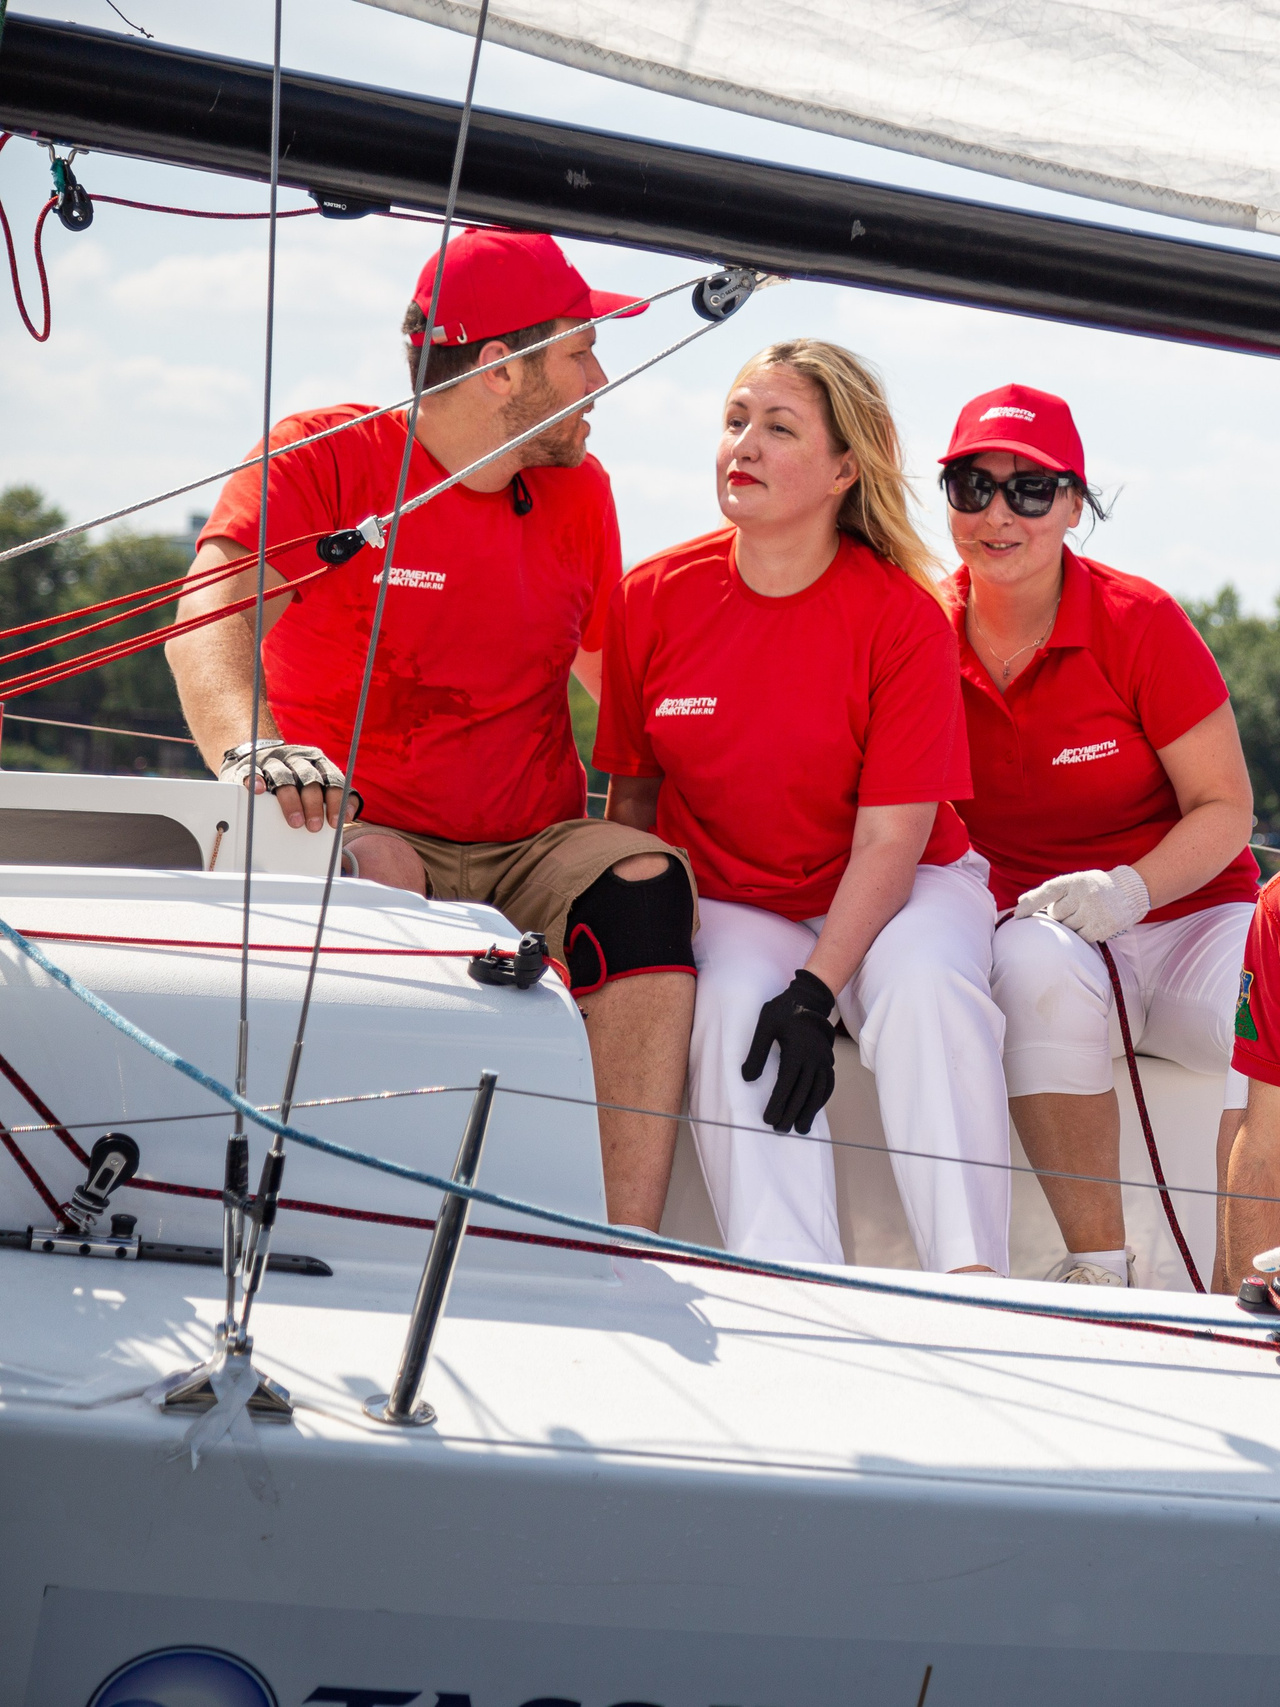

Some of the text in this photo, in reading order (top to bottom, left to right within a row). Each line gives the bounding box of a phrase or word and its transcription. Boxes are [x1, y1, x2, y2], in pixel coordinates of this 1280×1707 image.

[659, 697, 717, 709] АРГУМЕНТЫ
[690, 707, 715, 715] AIF.RU
[1055, 739, 1117, 758] АРГУМЕНТЫ
